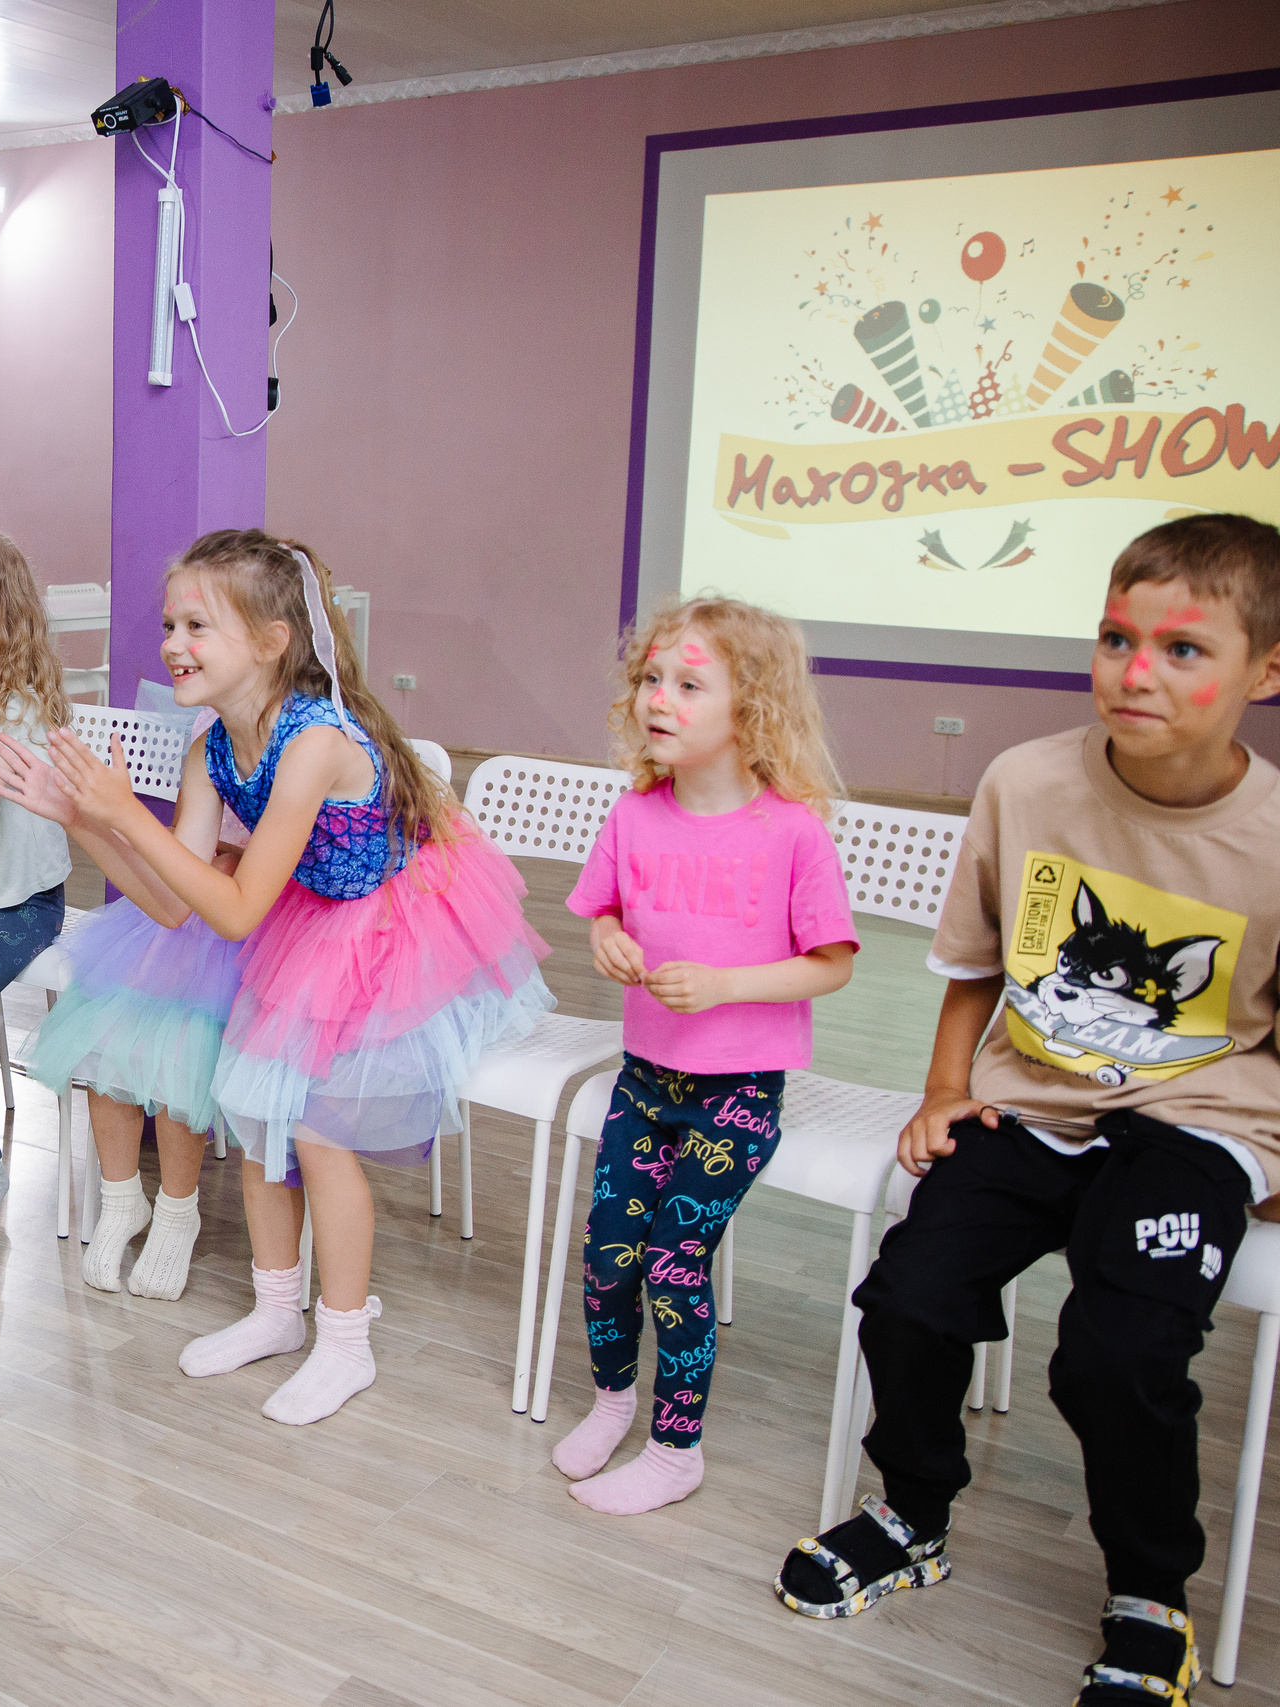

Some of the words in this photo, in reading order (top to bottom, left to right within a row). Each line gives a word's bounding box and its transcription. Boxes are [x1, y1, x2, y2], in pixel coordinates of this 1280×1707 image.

[1022, 897, 1043, 950] CAUTION!
[1076, 1020, 1181, 1060] EAM
[654, 1394, 703, 1434] Yea
